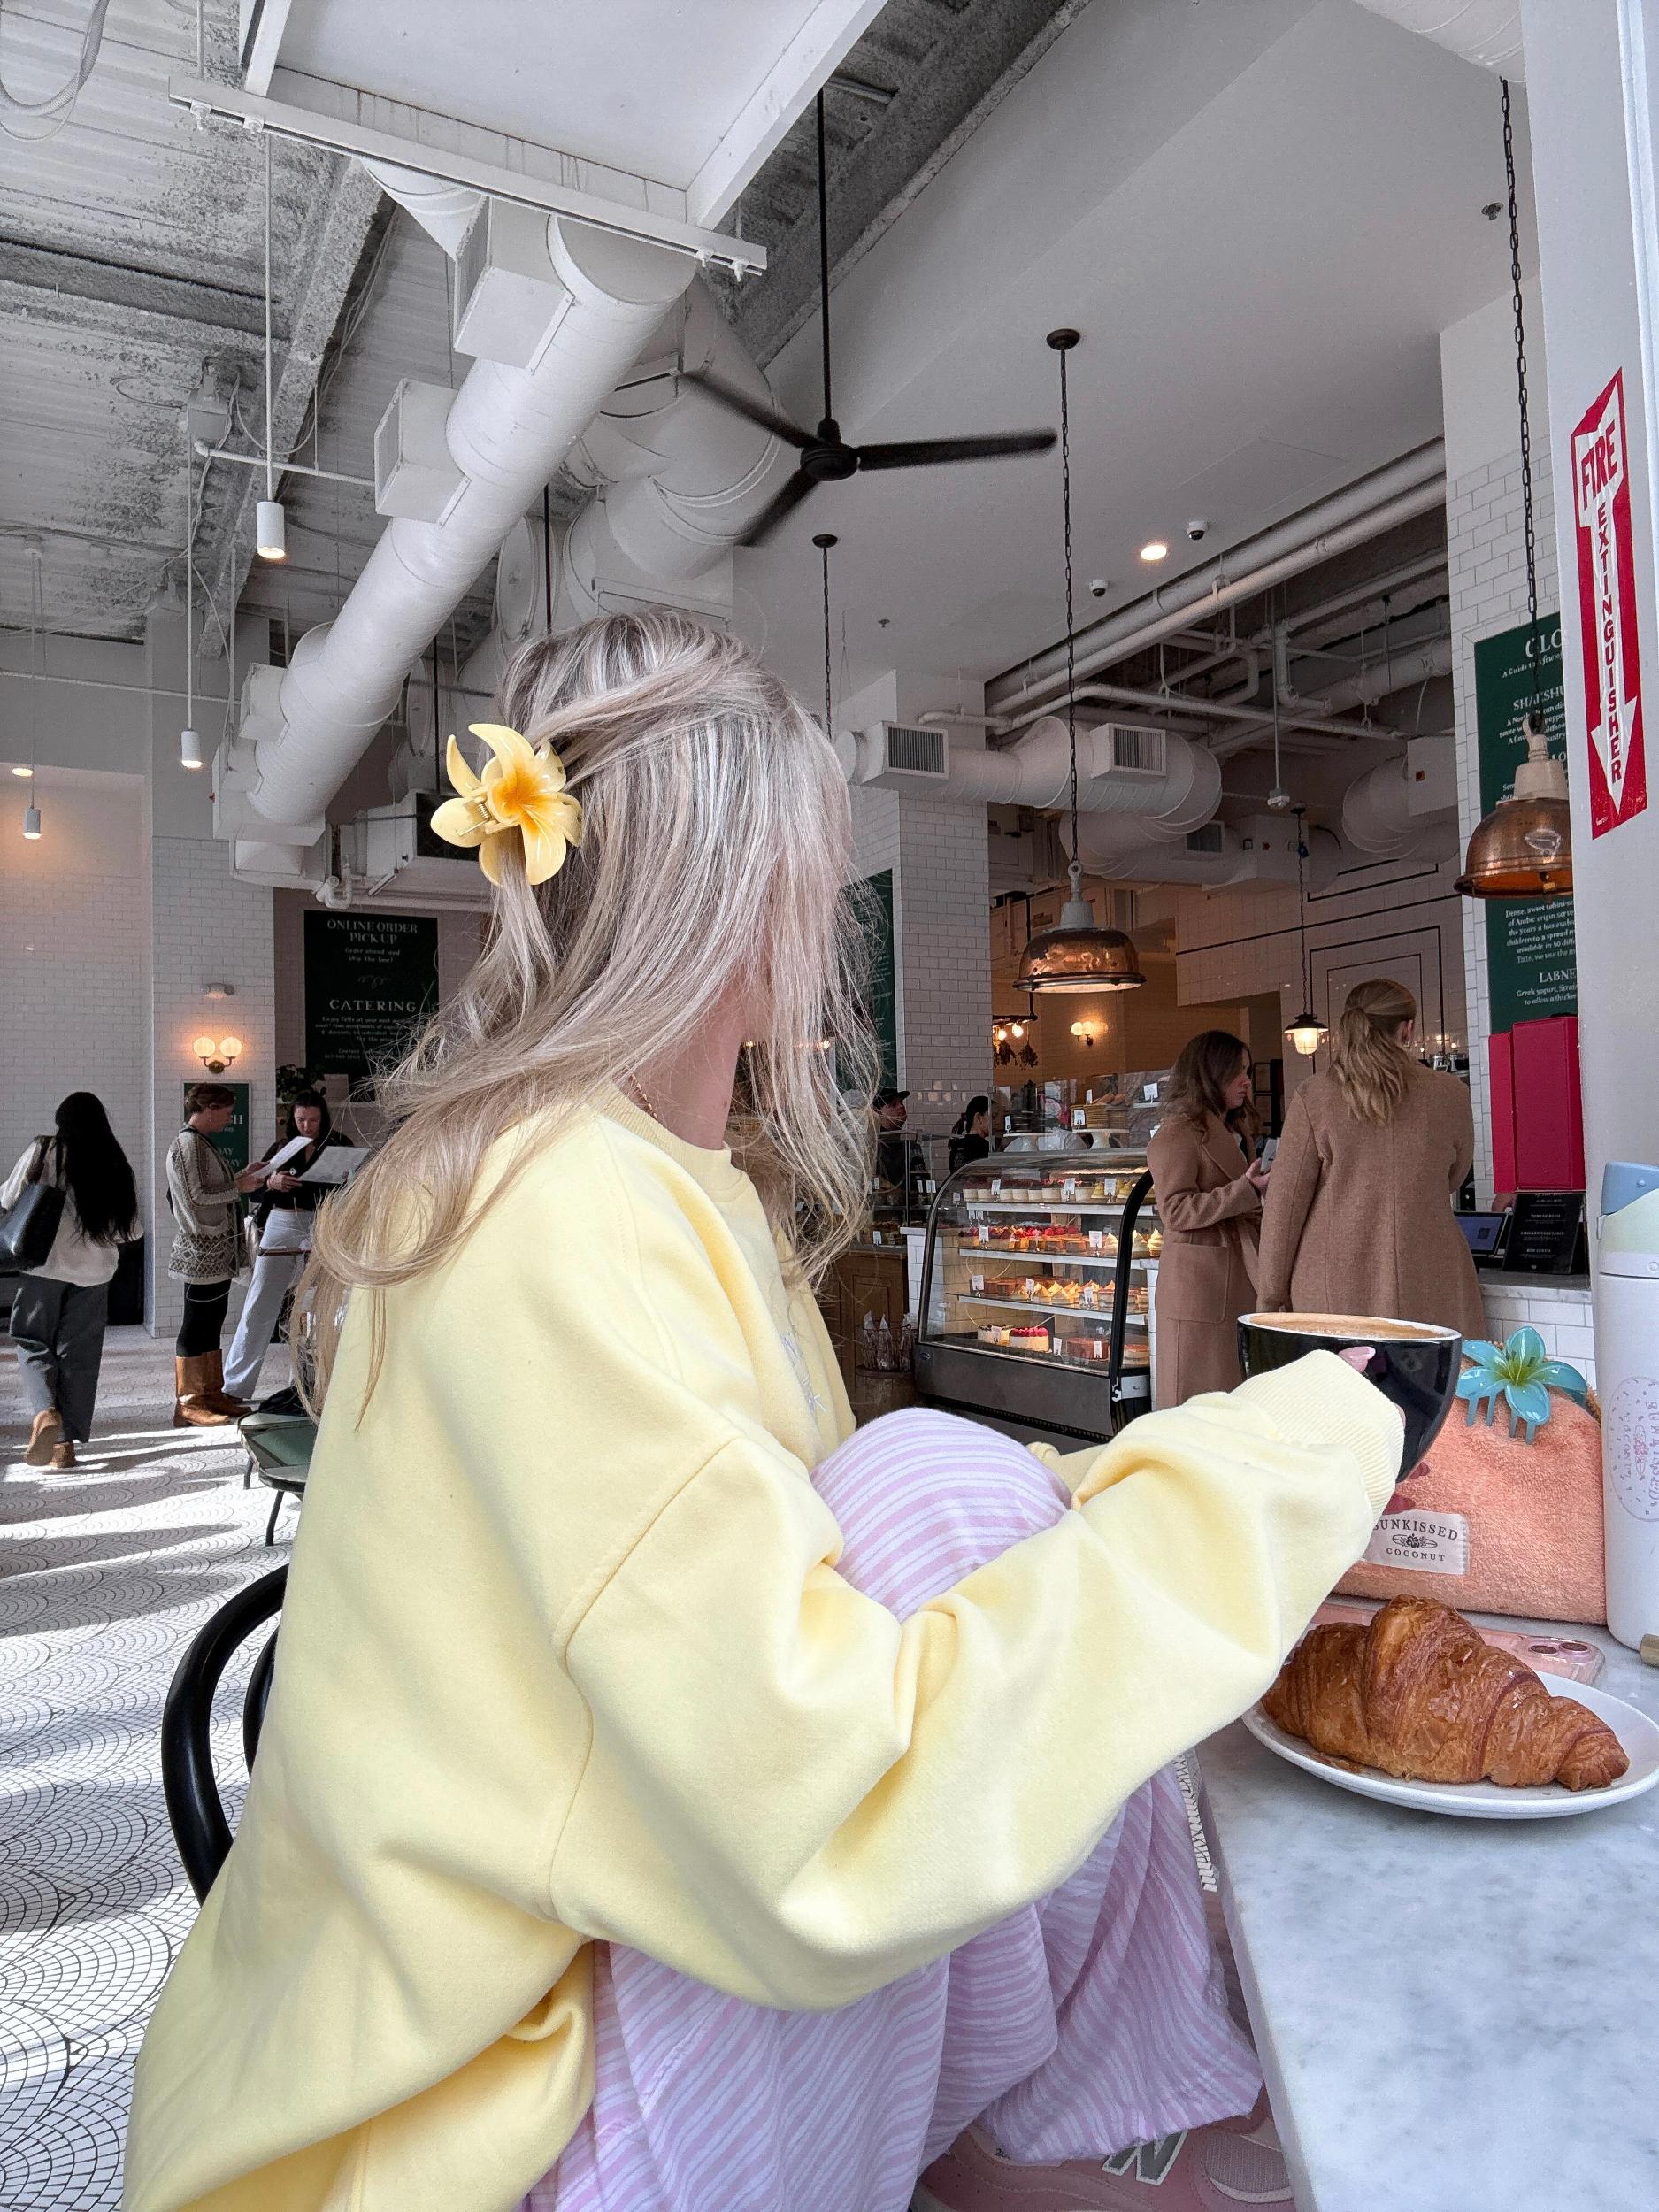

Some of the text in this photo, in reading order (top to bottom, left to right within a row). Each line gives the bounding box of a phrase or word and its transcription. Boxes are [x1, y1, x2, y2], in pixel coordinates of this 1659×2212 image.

[1580, 419, 1618, 511] FIRE
[1596, 502, 1622, 784] EXTINGUISHER
[327, 919, 418, 933] ONLINE ORDER
[349, 932, 398, 945] PICK UP
[329, 999, 417, 1013] CATERING
[1386, 1548, 1446, 1562] COCONUT
